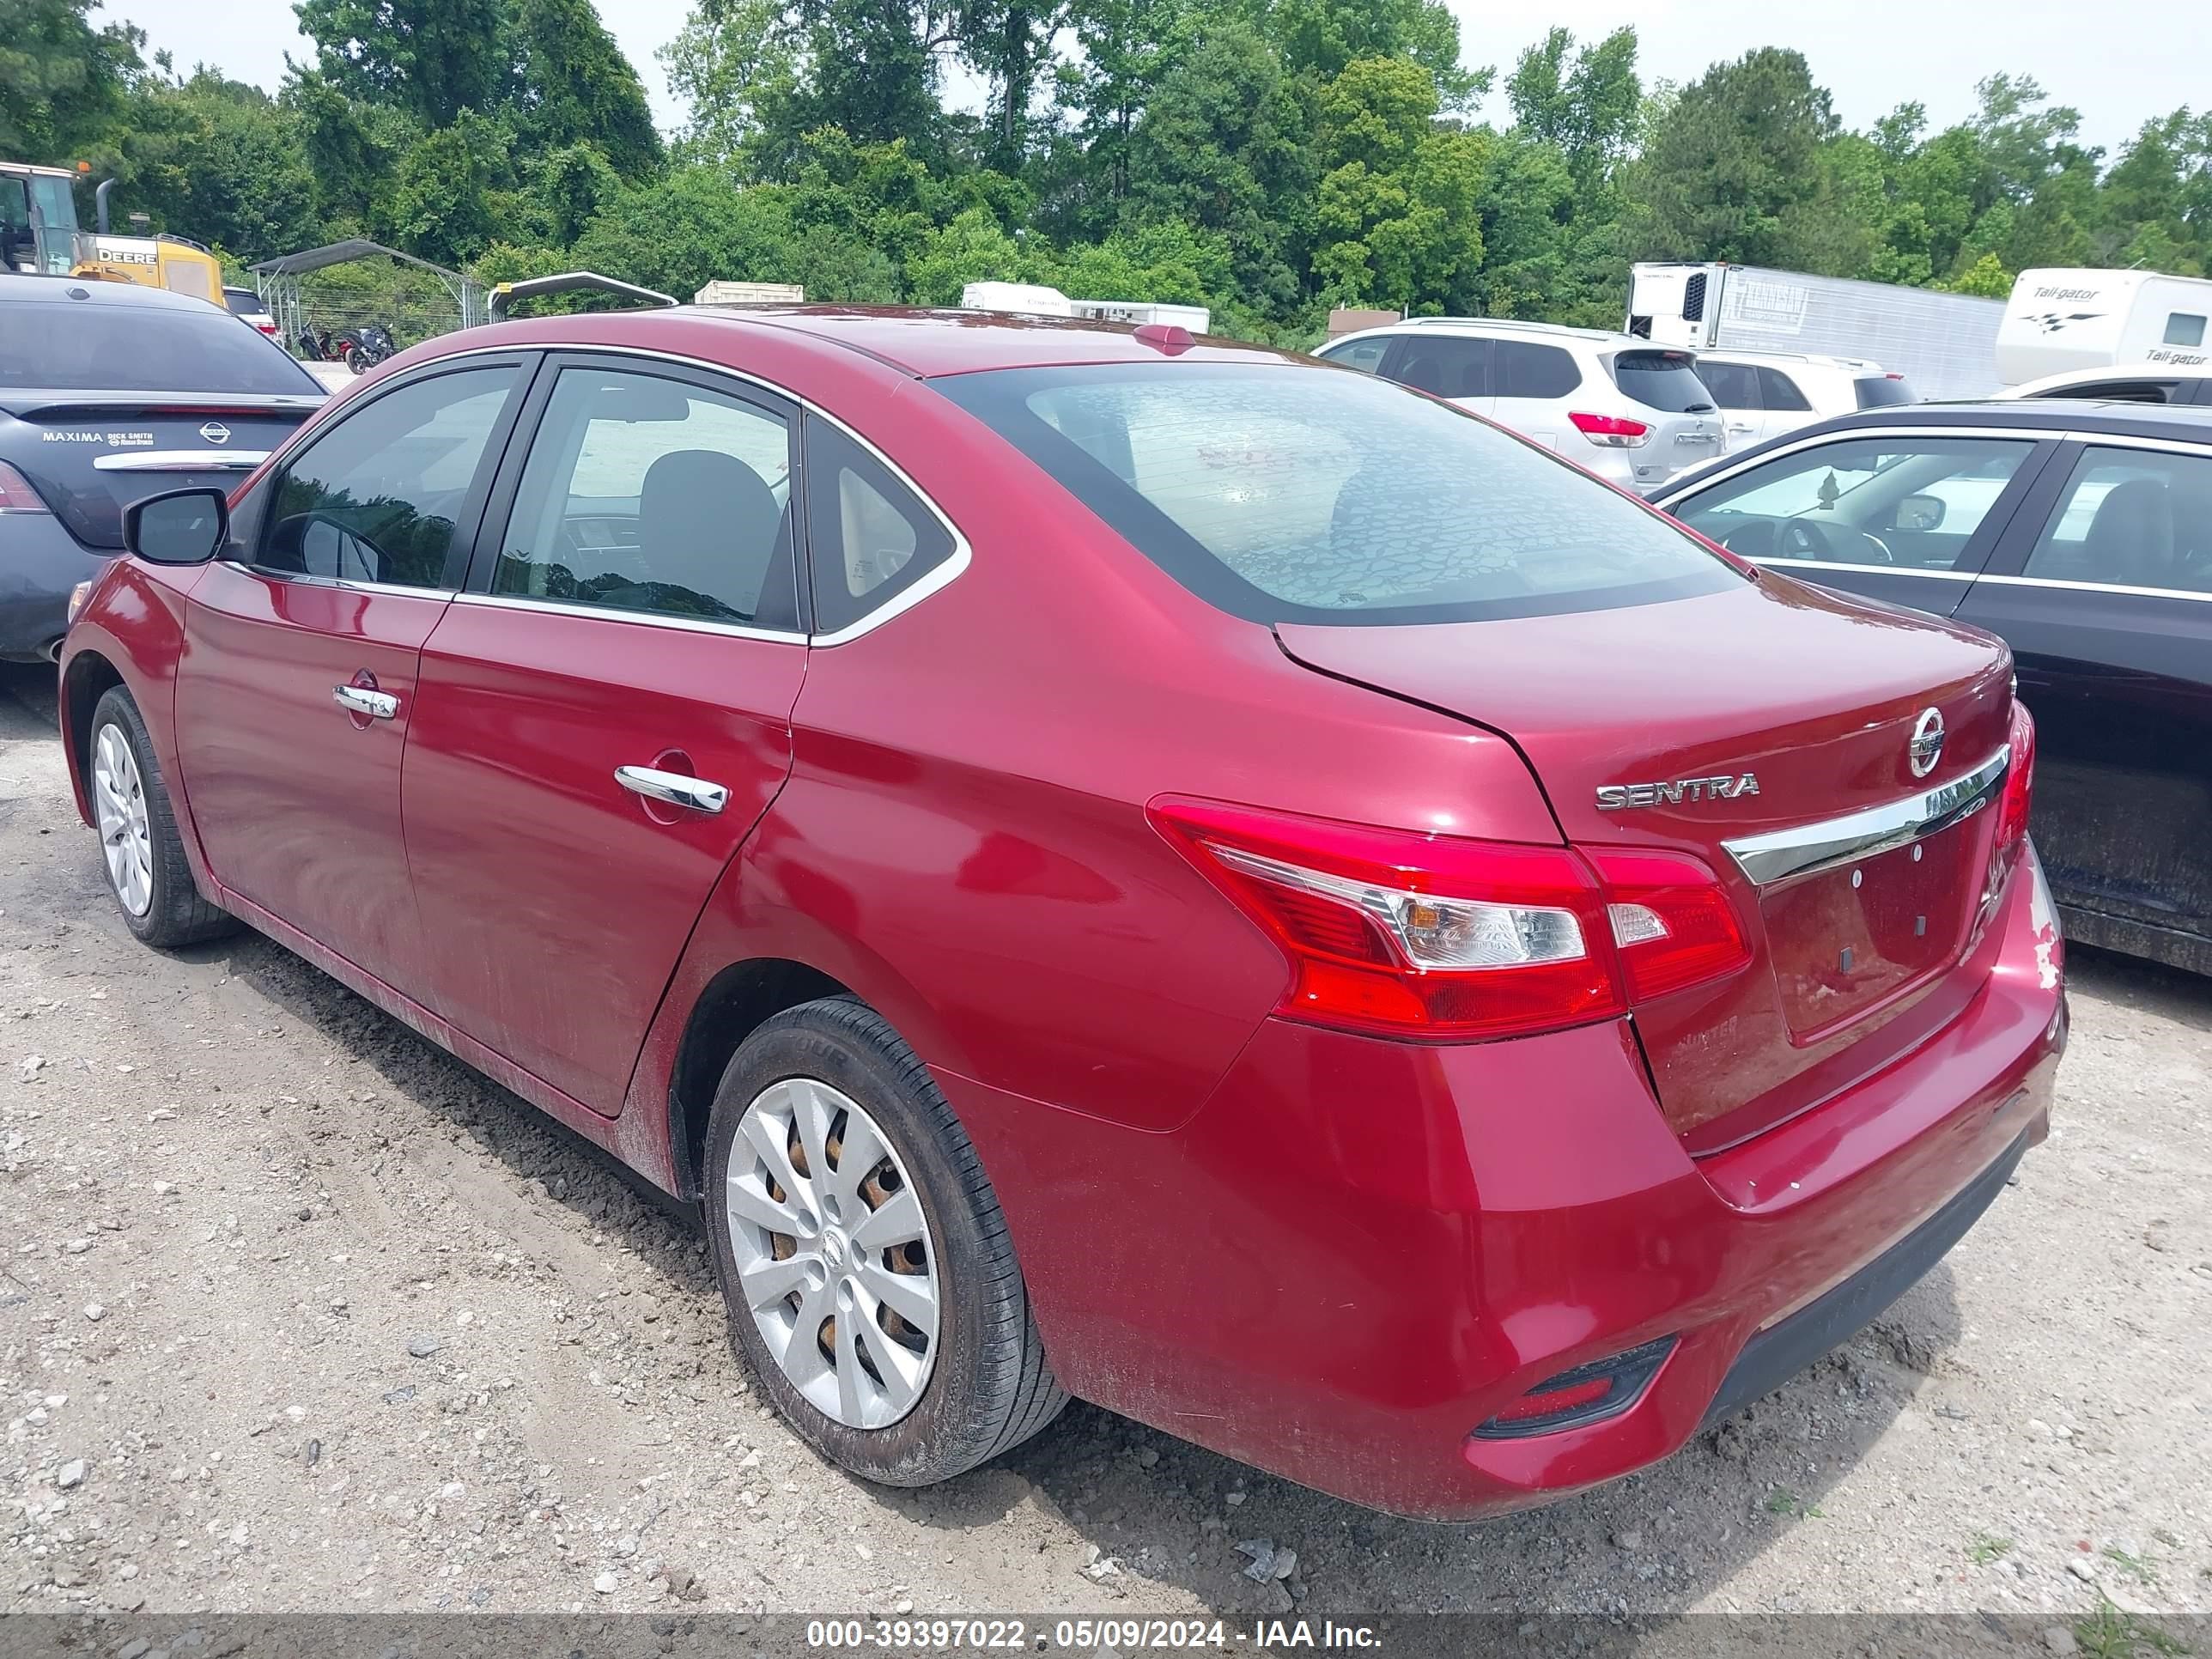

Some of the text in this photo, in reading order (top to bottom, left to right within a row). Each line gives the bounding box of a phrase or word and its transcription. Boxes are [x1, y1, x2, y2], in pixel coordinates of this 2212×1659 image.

[98, 248, 157, 265] DEERE
[43, 432, 104, 443] MAXIMA
[1595, 773, 1760, 811] SENTRA
